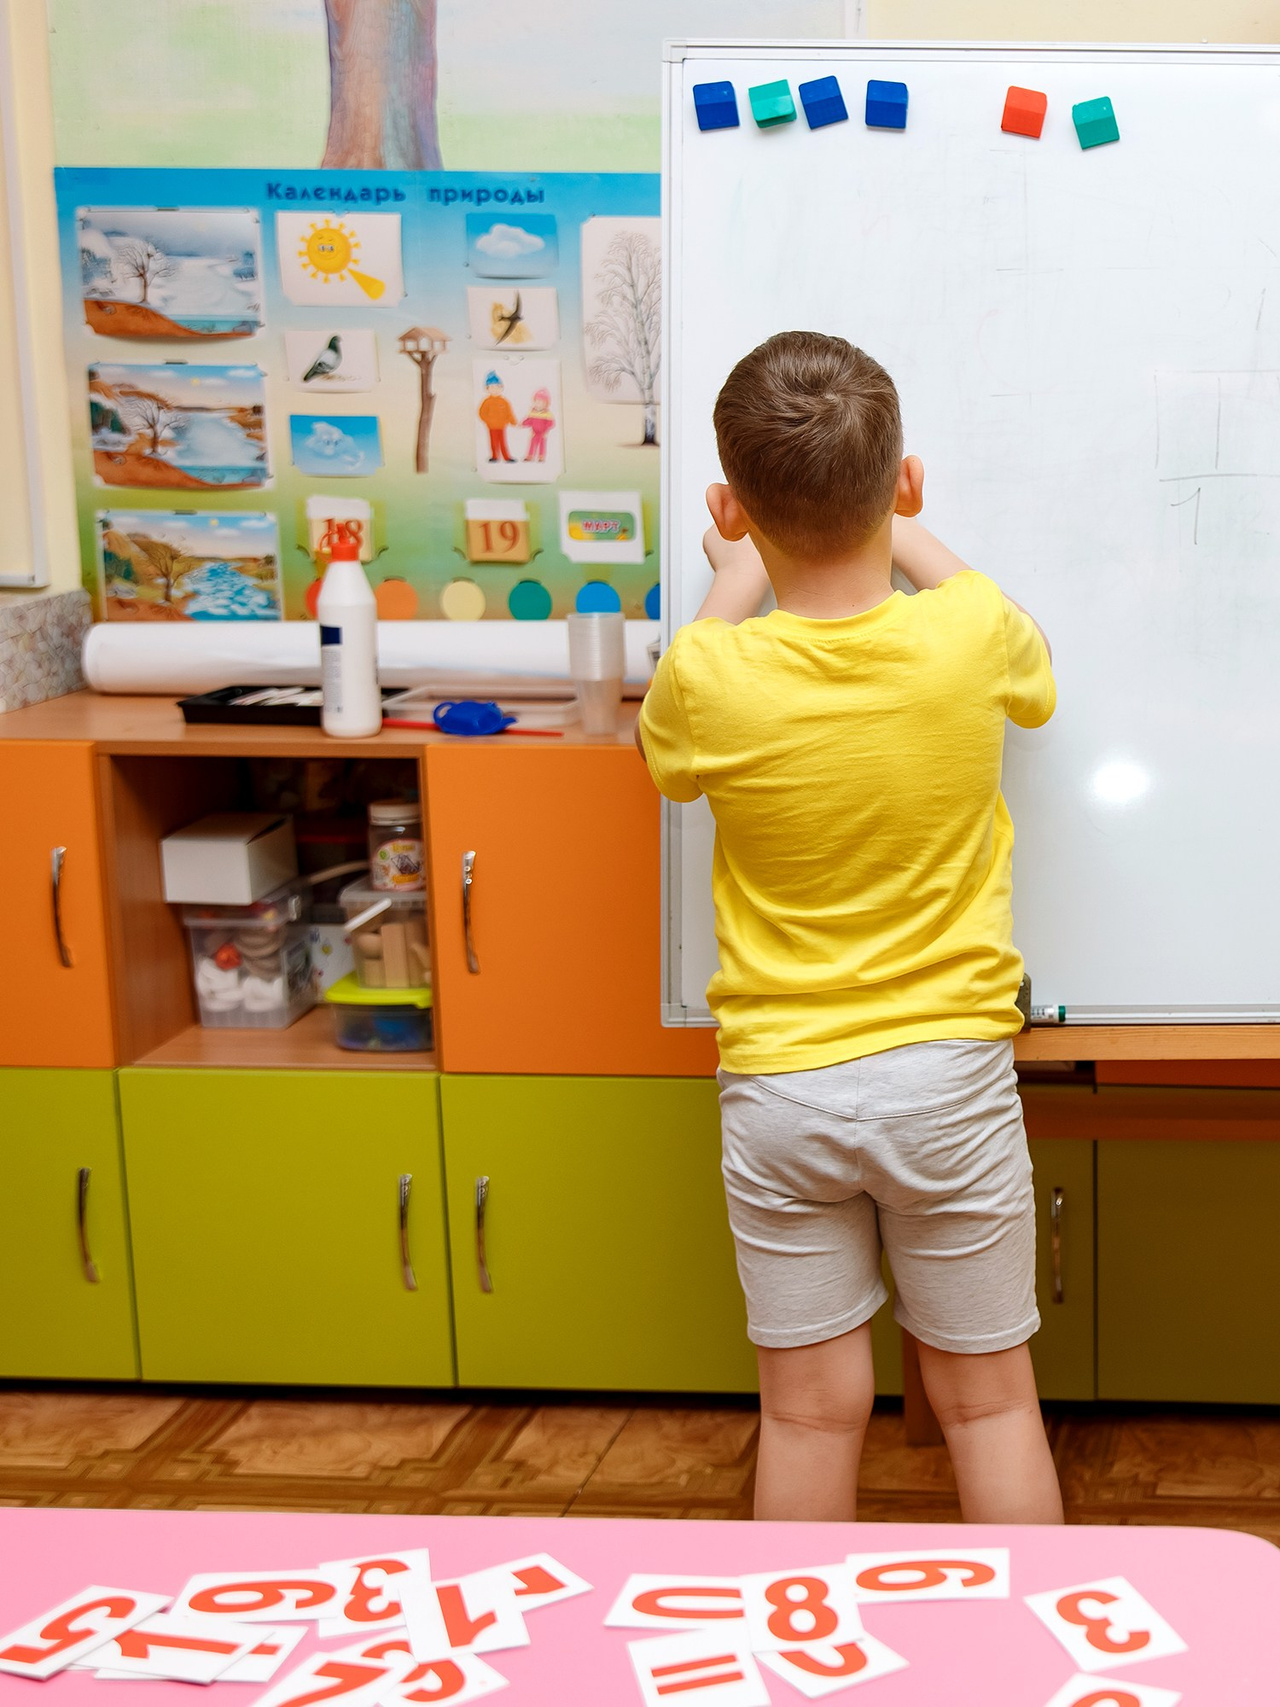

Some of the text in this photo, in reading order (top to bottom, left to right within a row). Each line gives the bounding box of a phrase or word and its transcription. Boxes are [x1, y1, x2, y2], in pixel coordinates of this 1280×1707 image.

[266, 182, 545, 206] Календарь природы
[479, 520, 520, 554] 19
[343, 1558, 410, 1623] 3
[764, 1576, 839, 1642] 8
[1055, 1589, 1151, 1654] 3
[0, 1596, 137, 1664] 5
